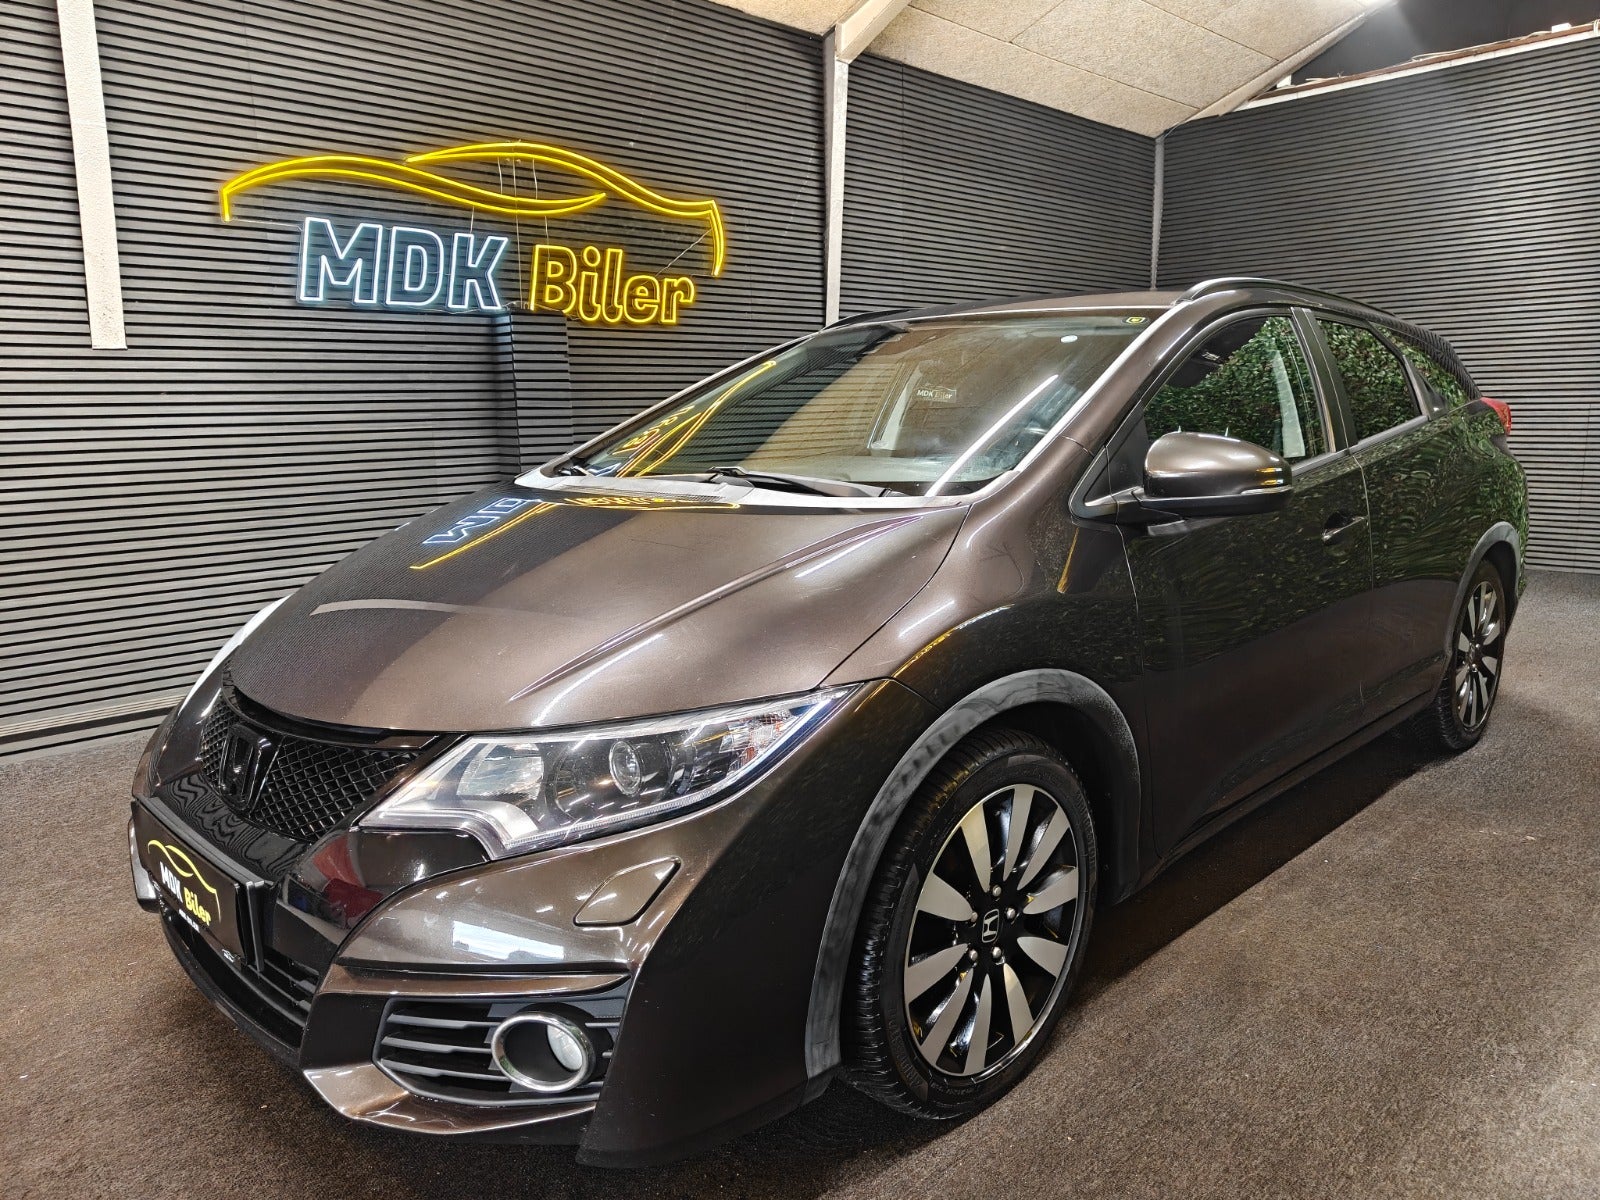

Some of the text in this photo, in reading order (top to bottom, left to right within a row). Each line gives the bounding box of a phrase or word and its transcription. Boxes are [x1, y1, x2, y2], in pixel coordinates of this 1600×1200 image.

[299, 216, 696, 325] MDK Biler
[917, 389, 933, 398] MDK
[160, 861, 184, 903] MDK
[183, 886, 212, 927] Biler
